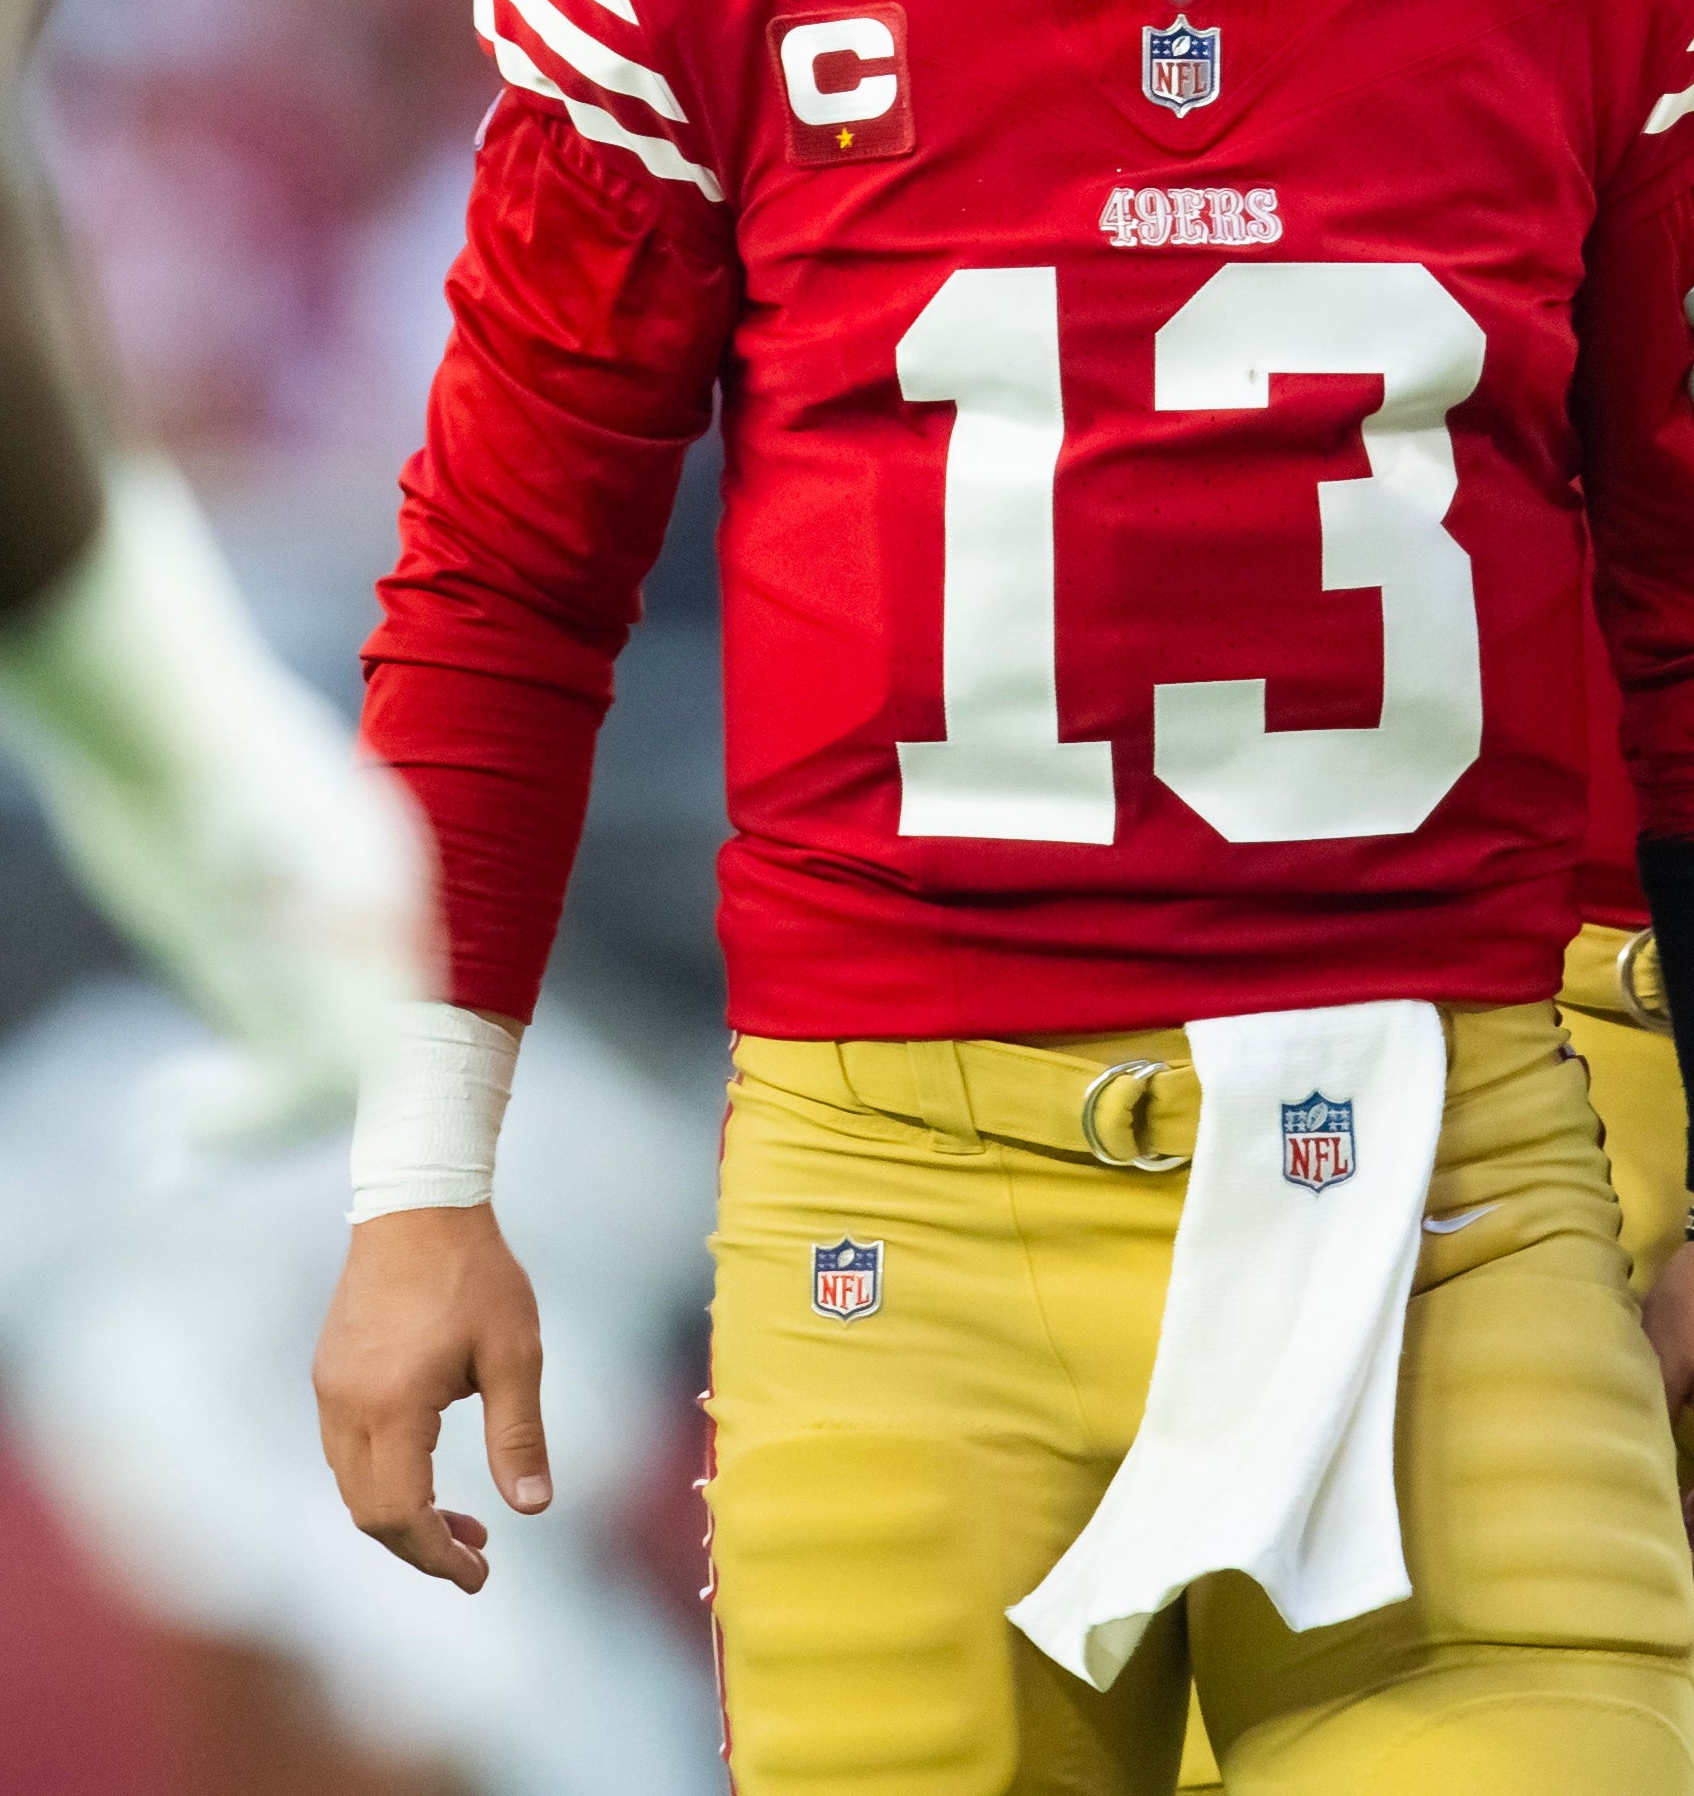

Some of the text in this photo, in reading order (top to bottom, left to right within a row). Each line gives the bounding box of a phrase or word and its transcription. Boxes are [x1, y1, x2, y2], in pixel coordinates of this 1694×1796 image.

[780, 17, 897, 125] C
[1155, 61, 1208, 99] NFL
[1098, 187, 1285, 247] 49ERS
[896, 262, 1487, 846] 13
[1288, 1136, 1349, 1183] NFL
[820, 1274, 871, 1311] NFL
